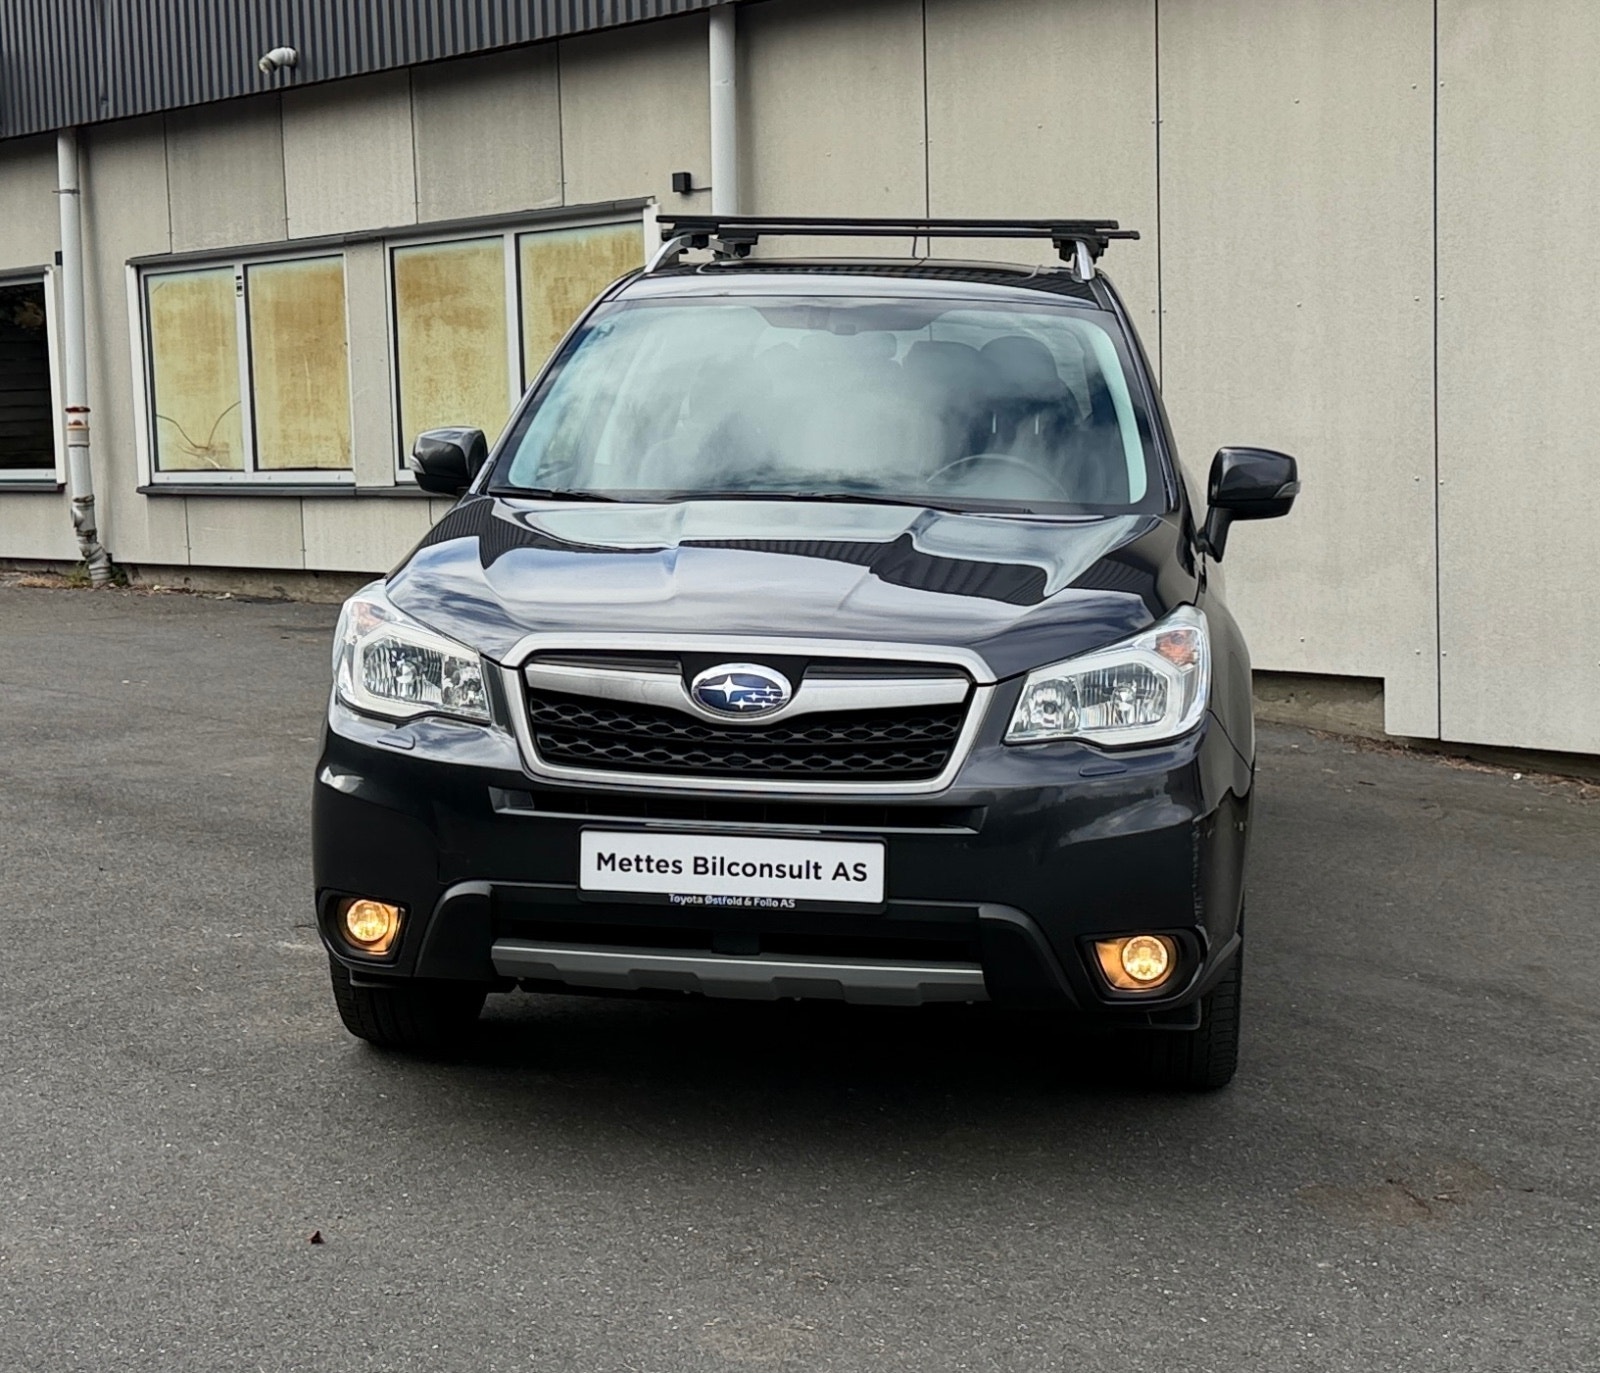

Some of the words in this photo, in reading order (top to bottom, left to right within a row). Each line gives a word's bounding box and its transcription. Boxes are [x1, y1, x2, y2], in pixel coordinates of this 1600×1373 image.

[596, 852, 683, 875] Mettes
[693, 856, 822, 880] Bilconsult
[832, 862, 868, 882] AS
[668, 893, 703, 905] Toyota
[704, 895, 743, 906] Østfold
[780, 899, 796, 909] AS
